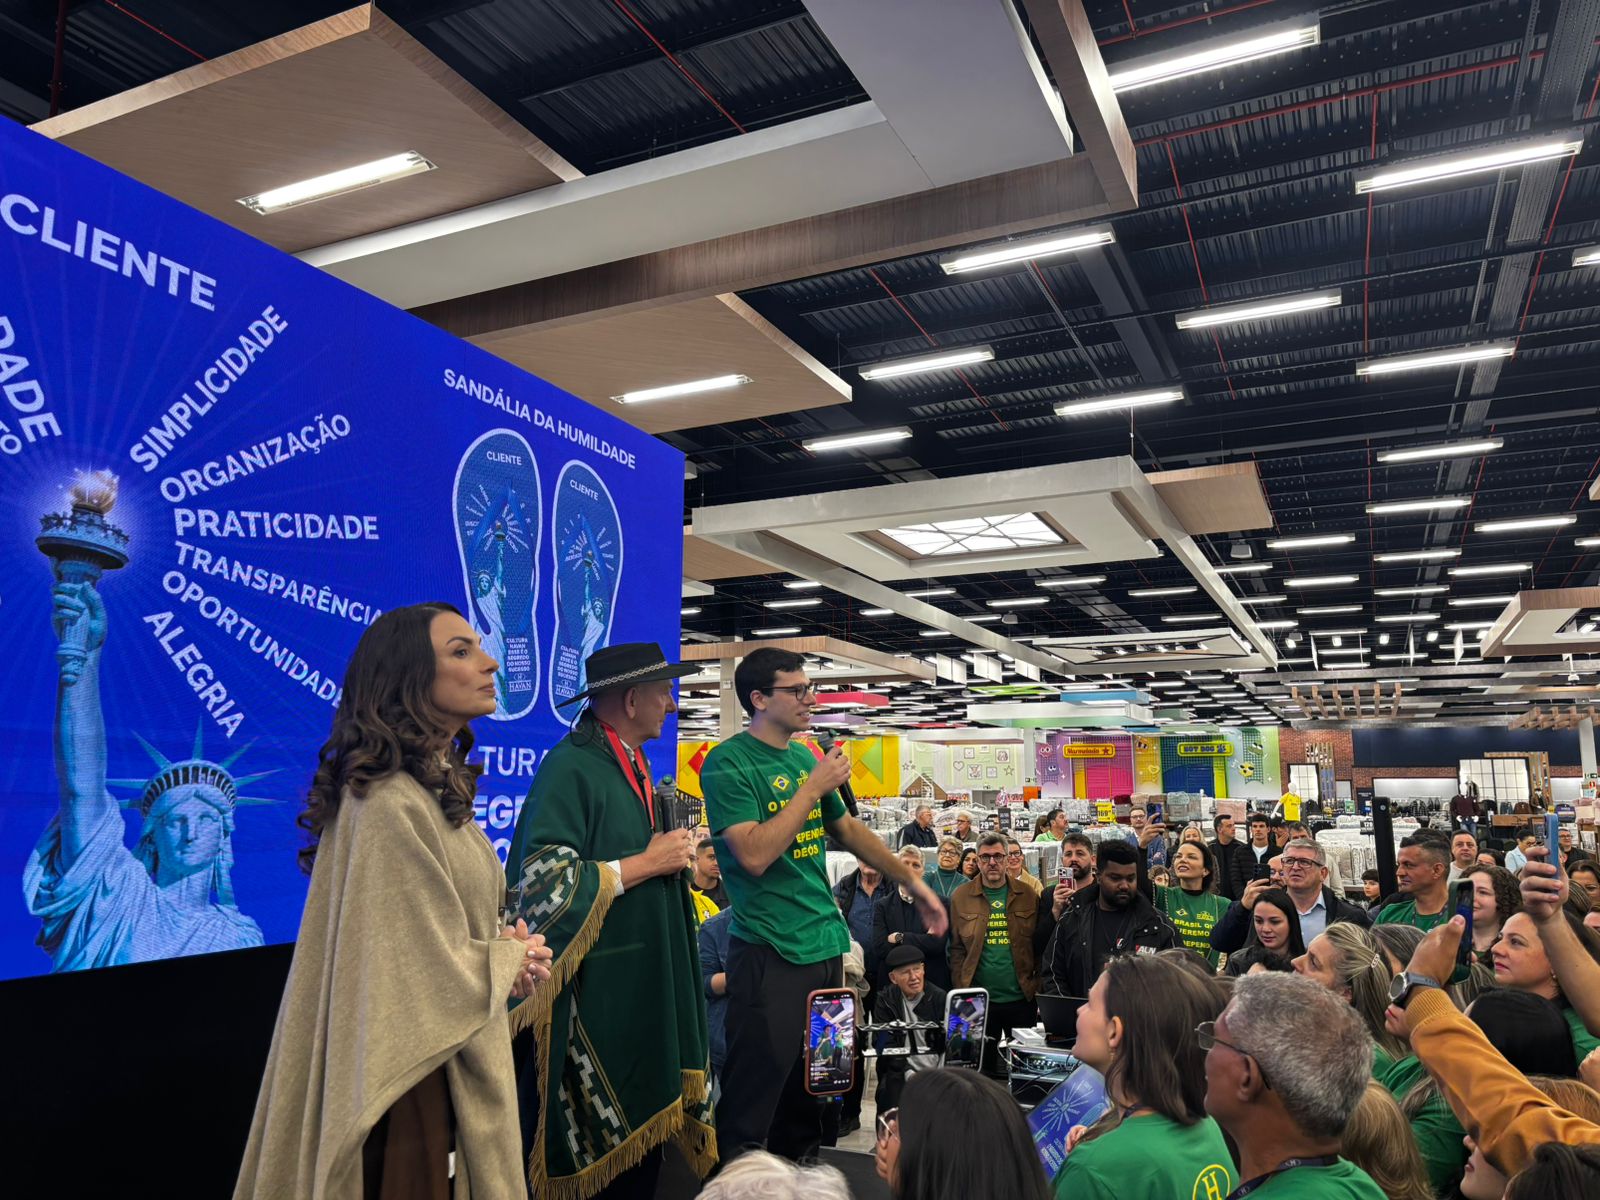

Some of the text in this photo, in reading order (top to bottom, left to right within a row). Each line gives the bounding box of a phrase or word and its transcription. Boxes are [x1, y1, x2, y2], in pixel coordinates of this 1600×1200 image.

[0, 194, 216, 312] CLIENTE
[129, 305, 288, 472] SIMPLICIDADE
[444, 368, 636, 469] SANDÁLIA DA HUMILDADE
[160, 413, 351, 502] ORGANIZAÇÃO
[486, 450, 522, 466] CLIENTE
[569, 479, 599, 501] CLIENTE
[174, 507, 379, 540] PRATICIDADE
[143, 609, 245, 738] ALEGRIA
[509, 681, 531, 692] HAVAN
[768, 801, 778, 812] O
[1174, 918, 1202, 928] BRASIL
